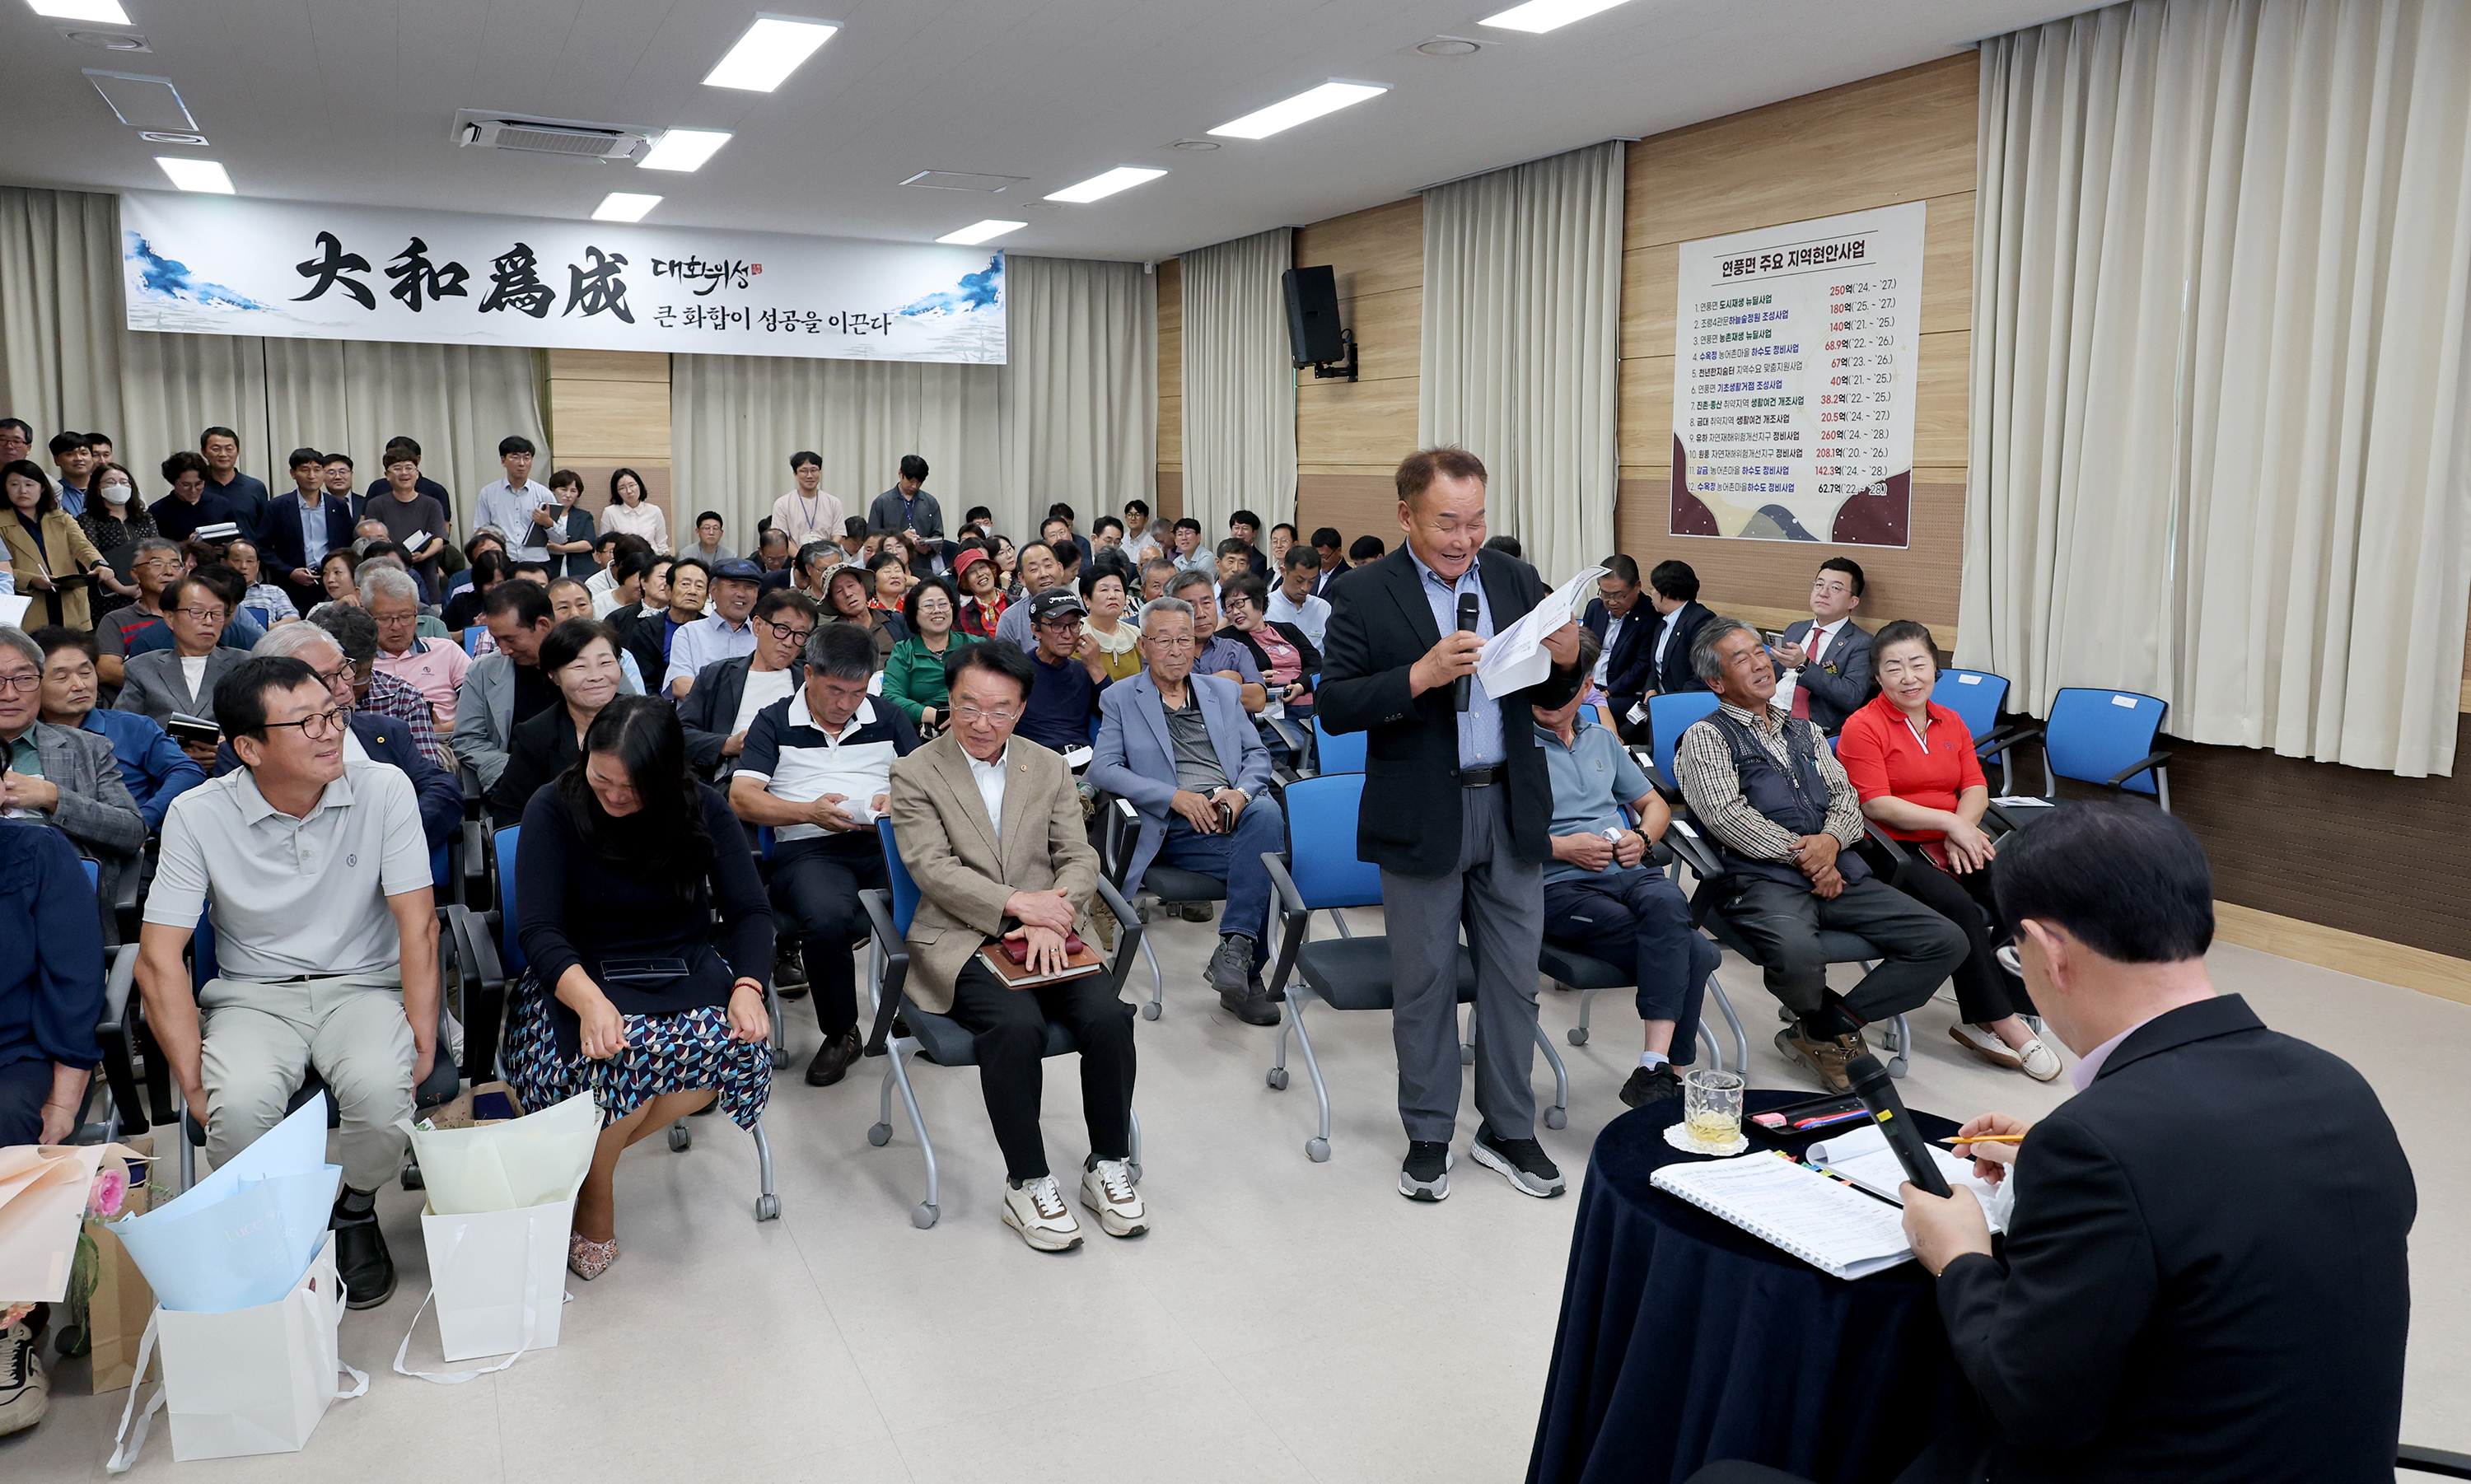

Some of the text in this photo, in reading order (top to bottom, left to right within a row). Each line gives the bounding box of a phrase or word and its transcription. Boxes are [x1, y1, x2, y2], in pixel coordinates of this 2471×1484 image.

[1722, 240, 1866, 278] 연풍면 주요 지역현안사업
[651, 255, 749, 296] 대화위성
[1700, 301, 1717, 311] 연풍면
[1720, 298, 1744, 310] 도시재생
[1746, 294, 1772, 306] 뉴딜사업
[653, 305, 892, 336] 큰 화합이 성공을 이끈다
[1694, 320, 1699, 329] 2.
[1763, 310, 1788, 321] 조성사업
[1693, 337, 1698, 345] 3.
[1701, 334, 1717, 344] 연풍면
[1720, 331, 1744, 343] 농촌재생
[1746, 329, 1772, 340] 뉴딜사업
[1700, 351, 1717, 361] 수옥정
[1719, 348, 1749, 359] 농어촌마을
[1751, 347, 1771, 356] 하수도
[1773, 343, 1799, 355] 정비사업
[1692, 370, 1698, 378] 5.
[1736, 364, 1762, 375] 지역수요
[1763, 361, 1802, 372] 맞춤지원사업
[1692, 385, 1697, 394] 6.
[1698, 384, 1716, 394] 연풍면
[1717, 381, 1754, 392] 기초생활거점
[1757, 380, 1782, 390] 조성사업
[1691, 402, 1695, 410] 7.
[1724, 399, 1749, 408] 취약지역
[1751, 397, 1776, 408] 생활여건
[1778, 395, 1804, 406] 개조사업
[1690, 418, 1695, 427] 8.
[1697, 417, 1708, 427] 금대
[1710, 416, 1734, 426] 취약지역
[1736, 415, 1761, 425] 생활여건
[1763, 413, 1789, 424] 개조사업
[1689, 434, 1694, 442] 9.
[1696, 433, 1707, 442] 유하
[1709, 432, 1772, 442] 자연재해위험개선지구
[1773, 431, 1800, 441] 정비사업
[1712, 449, 1774, 459] 자연재해위험개선지구
[1776, 448, 1803, 458] 정비사업
[1710, 466, 1740, 475] 농어촌마을
[1742, 466, 1761, 475] 하수도
[1763, 466, 1789, 475] 정비사업
[1698, 482, 1717, 491] 수옥정
[1768, 483, 1794, 492] 정비사업
[224, 1219, 263, 1242] Luce
